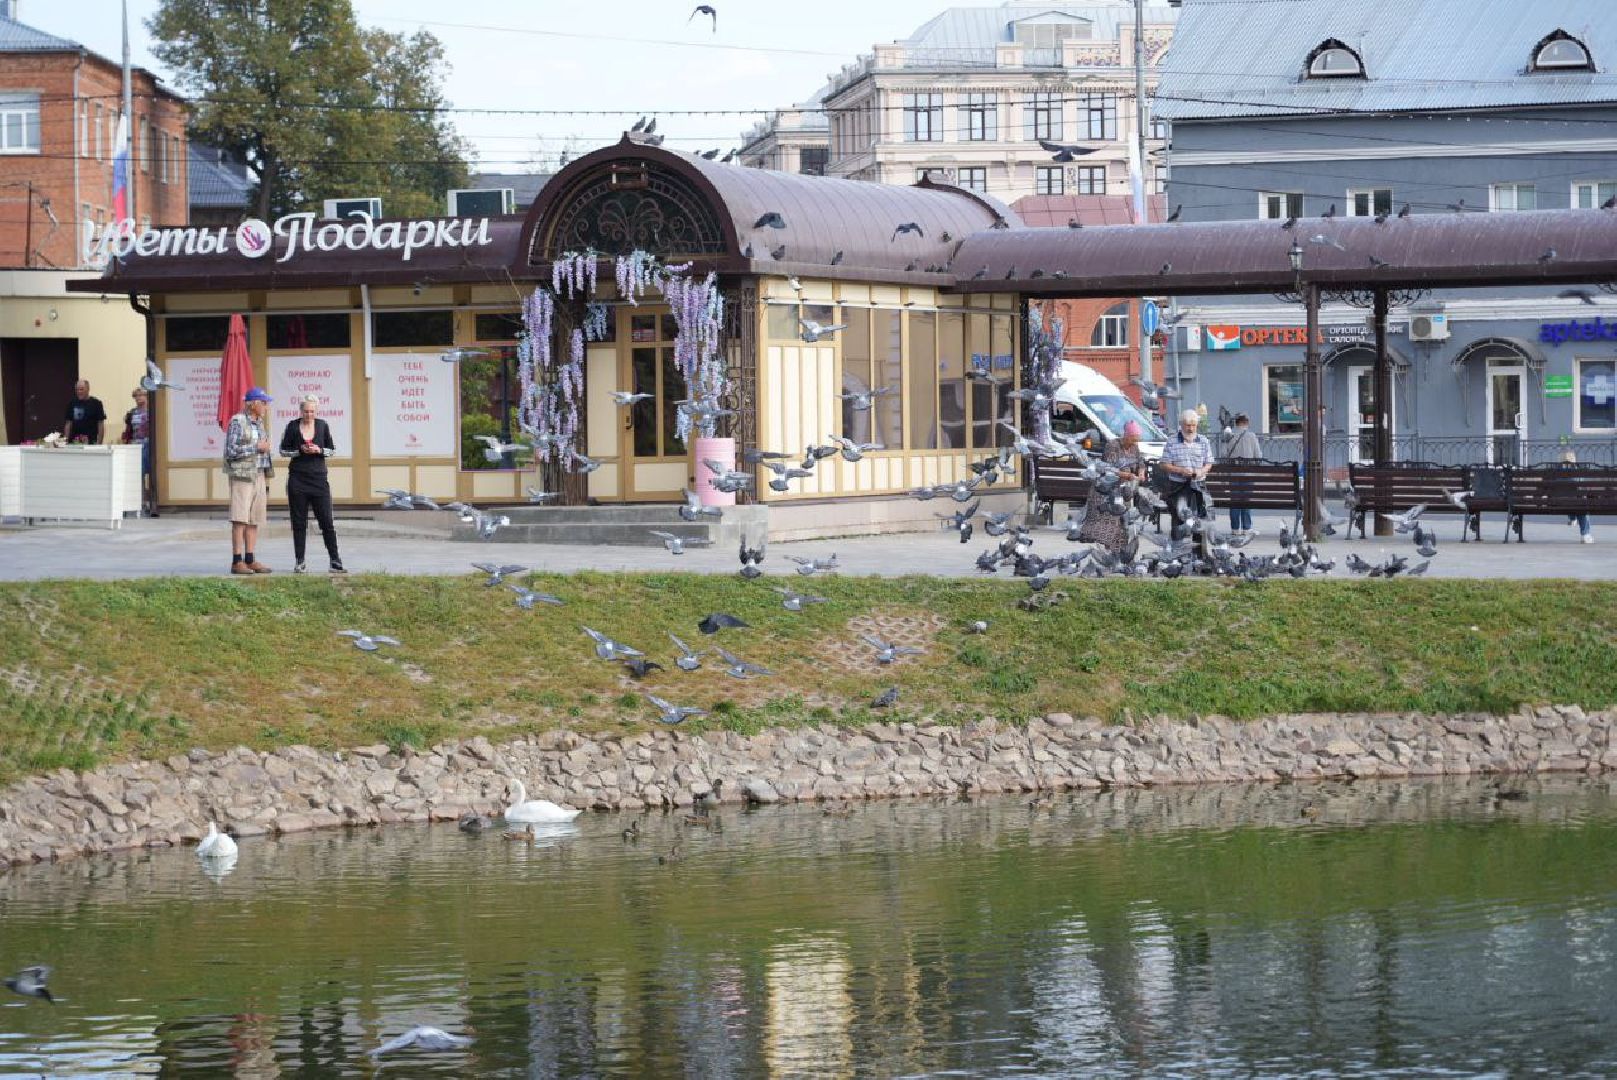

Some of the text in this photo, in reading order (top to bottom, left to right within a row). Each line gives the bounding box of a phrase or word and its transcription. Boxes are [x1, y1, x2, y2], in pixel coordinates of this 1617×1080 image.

[82, 211, 492, 266] Цветы Подарки
[398, 375, 429, 384] ОЧЕНЬ
[401, 400, 425, 409] БЫТЬ
